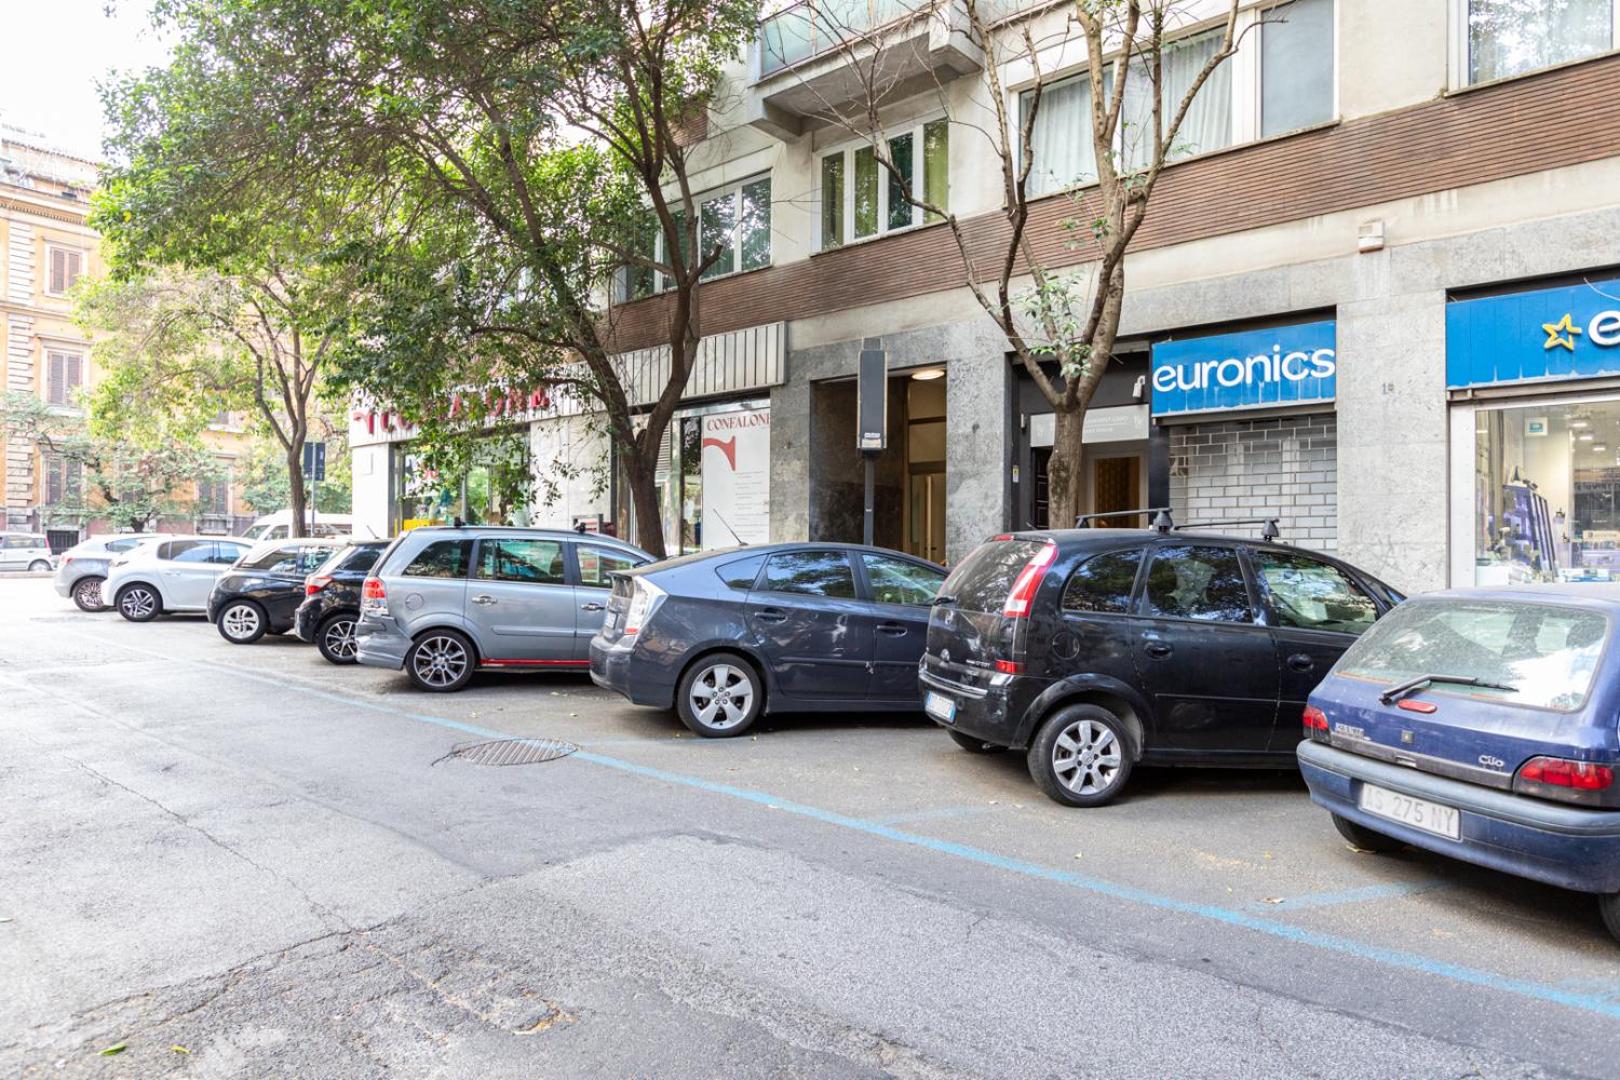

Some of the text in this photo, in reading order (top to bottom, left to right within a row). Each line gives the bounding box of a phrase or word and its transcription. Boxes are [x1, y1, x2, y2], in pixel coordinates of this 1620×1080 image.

[1152, 344, 1336, 392] euronics
[1478, 754, 1505, 768] Clio
[1365, 786, 1454, 832] AS 275 NY
